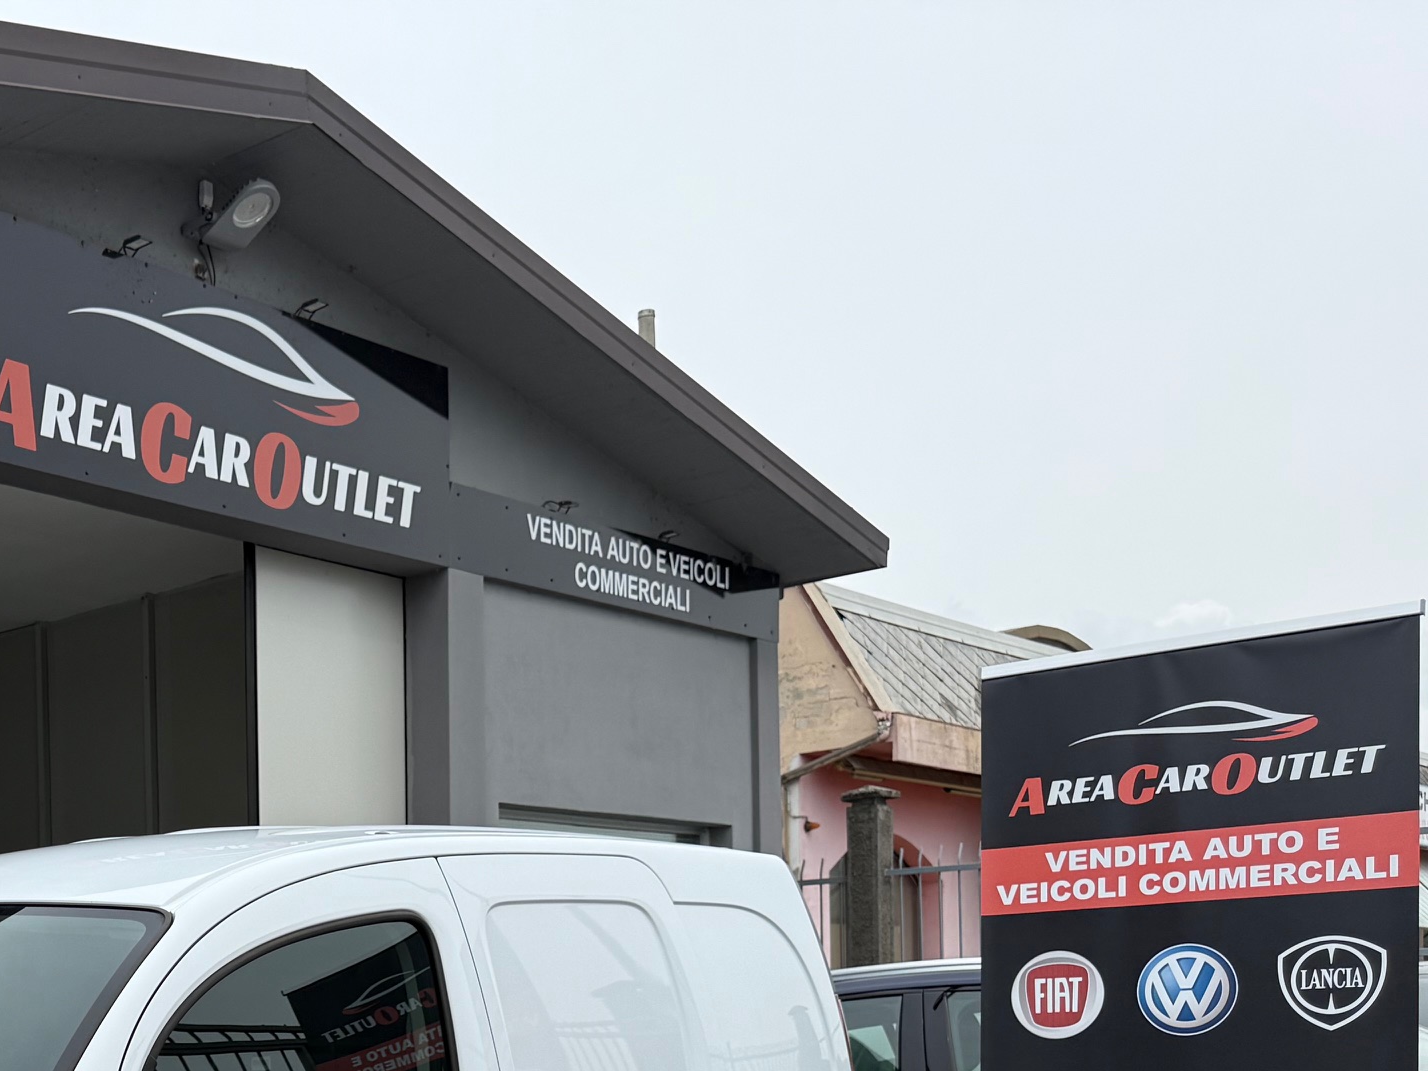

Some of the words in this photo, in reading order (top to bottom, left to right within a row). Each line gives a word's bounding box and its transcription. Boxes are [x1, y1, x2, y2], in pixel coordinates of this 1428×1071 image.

[526, 513, 604, 558] VENDITA
[606, 534, 653, 571] AUTO
[655, 547, 667, 573] E
[669, 549, 731, 591] VEICOLI
[574, 561, 691, 613] COMMERCIALI
[1044, 841, 1193, 873] VENDITA
[1203, 832, 1304, 860] AUTO
[1318, 827, 1341, 851] E
[997, 876, 1127, 906] VEICOLI
[1138, 855, 1400, 895] COMMERCIALI
[1034, 976, 1083, 1014] FIAT
[1300, 967, 1365, 990] LANCIA
